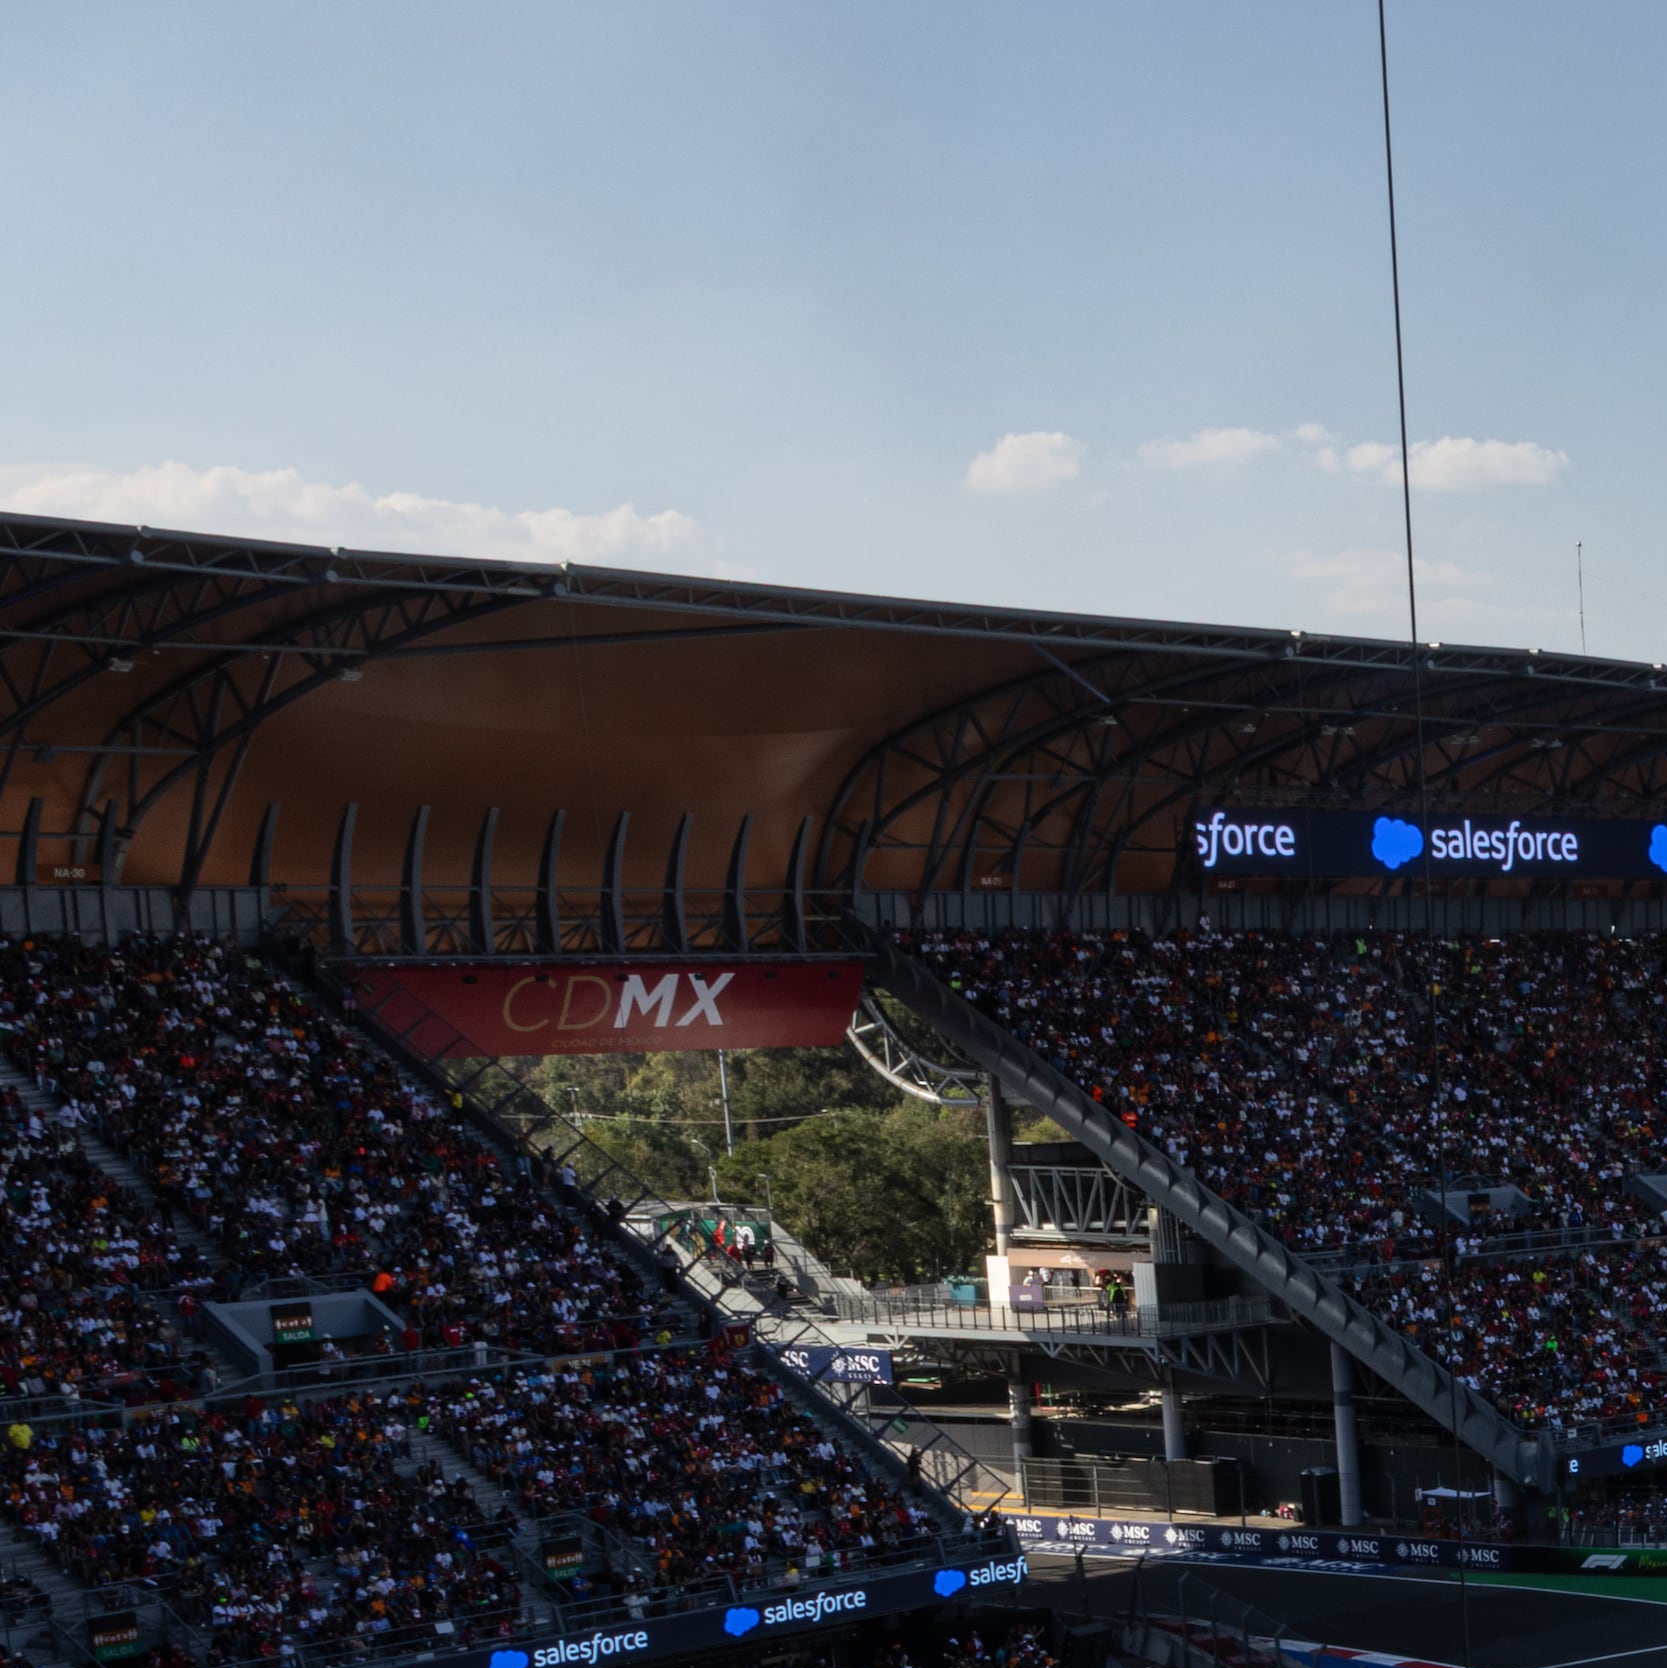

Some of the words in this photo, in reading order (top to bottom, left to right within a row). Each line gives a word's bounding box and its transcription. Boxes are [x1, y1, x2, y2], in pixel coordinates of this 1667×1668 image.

[1432, 820, 1578, 870] salesforce
[503, 973, 735, 1031] CDMX
[282, 1331, 311, 1341] SALIDA
[847, 1354, 880, 1372] MSC
[1017, 1519, 1042, 1533] MSC
[1069, 1522, 1095, 1536] MSC
[1123, 1525, 1150, 1539] MSC
[1178, 1528, 1205, 1542] MSC
[1234, 1532, 1261, 1546] MSC
[1291, 1535, 1319, 1549] MSC
[1351, 1539, 1379, 1554] MSC
[1410, 1544, 1439, 1558] MSC
[1471, 1548, 1500, 1563] MSC
[764, 1590, 866, 1624] salesforce
[533, 1631, 648, 1667] salesforce
